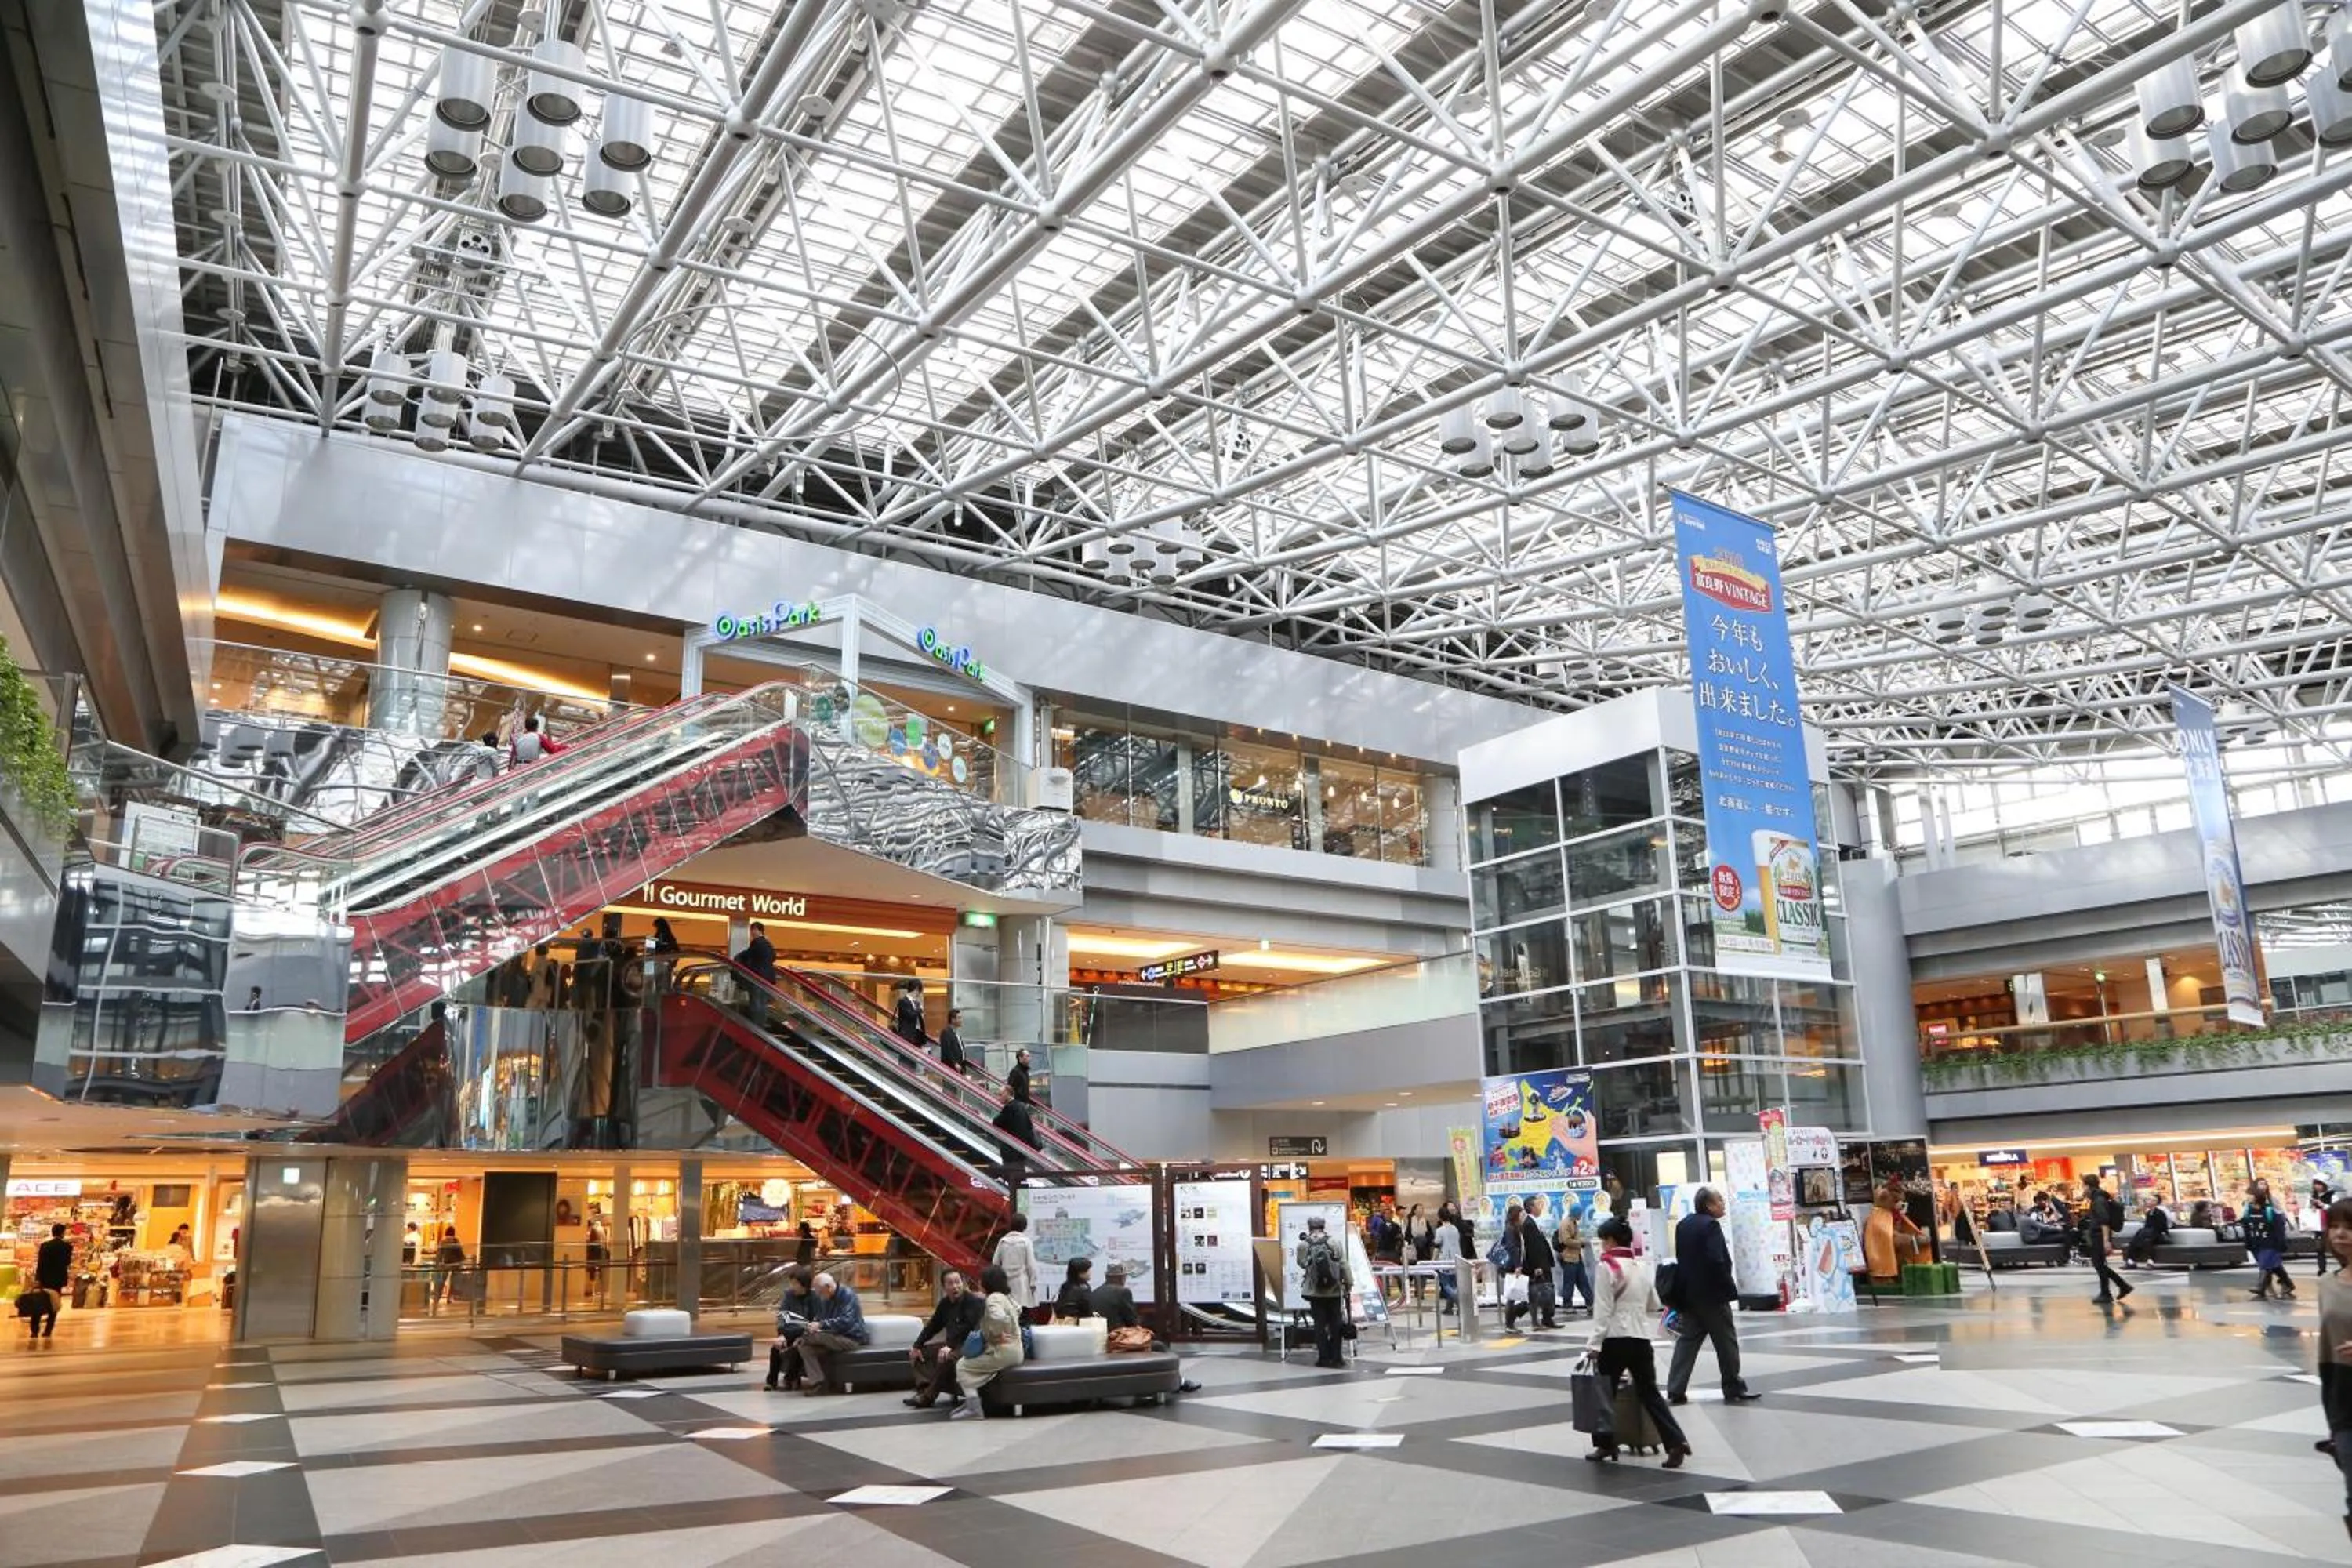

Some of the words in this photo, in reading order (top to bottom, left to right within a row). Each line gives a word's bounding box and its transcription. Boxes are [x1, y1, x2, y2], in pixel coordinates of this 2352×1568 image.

[714, 610, 771, 641] Oasis
[771, 600, 821, 633] Park
[1711, 614, 1762, 652] 今年も
[916, 626, 953, 666] Oasis
[1700, 681, 1796, 728] 出来ました。
[1244, 794, 1288, 808] PRONTO
[659, 885, 746, 912] Gourmet
[751, 894, 806, 916] World
[1777, 899, 1820, 927] CLASSIC
[15, 1182, 71, 1192] ACE
